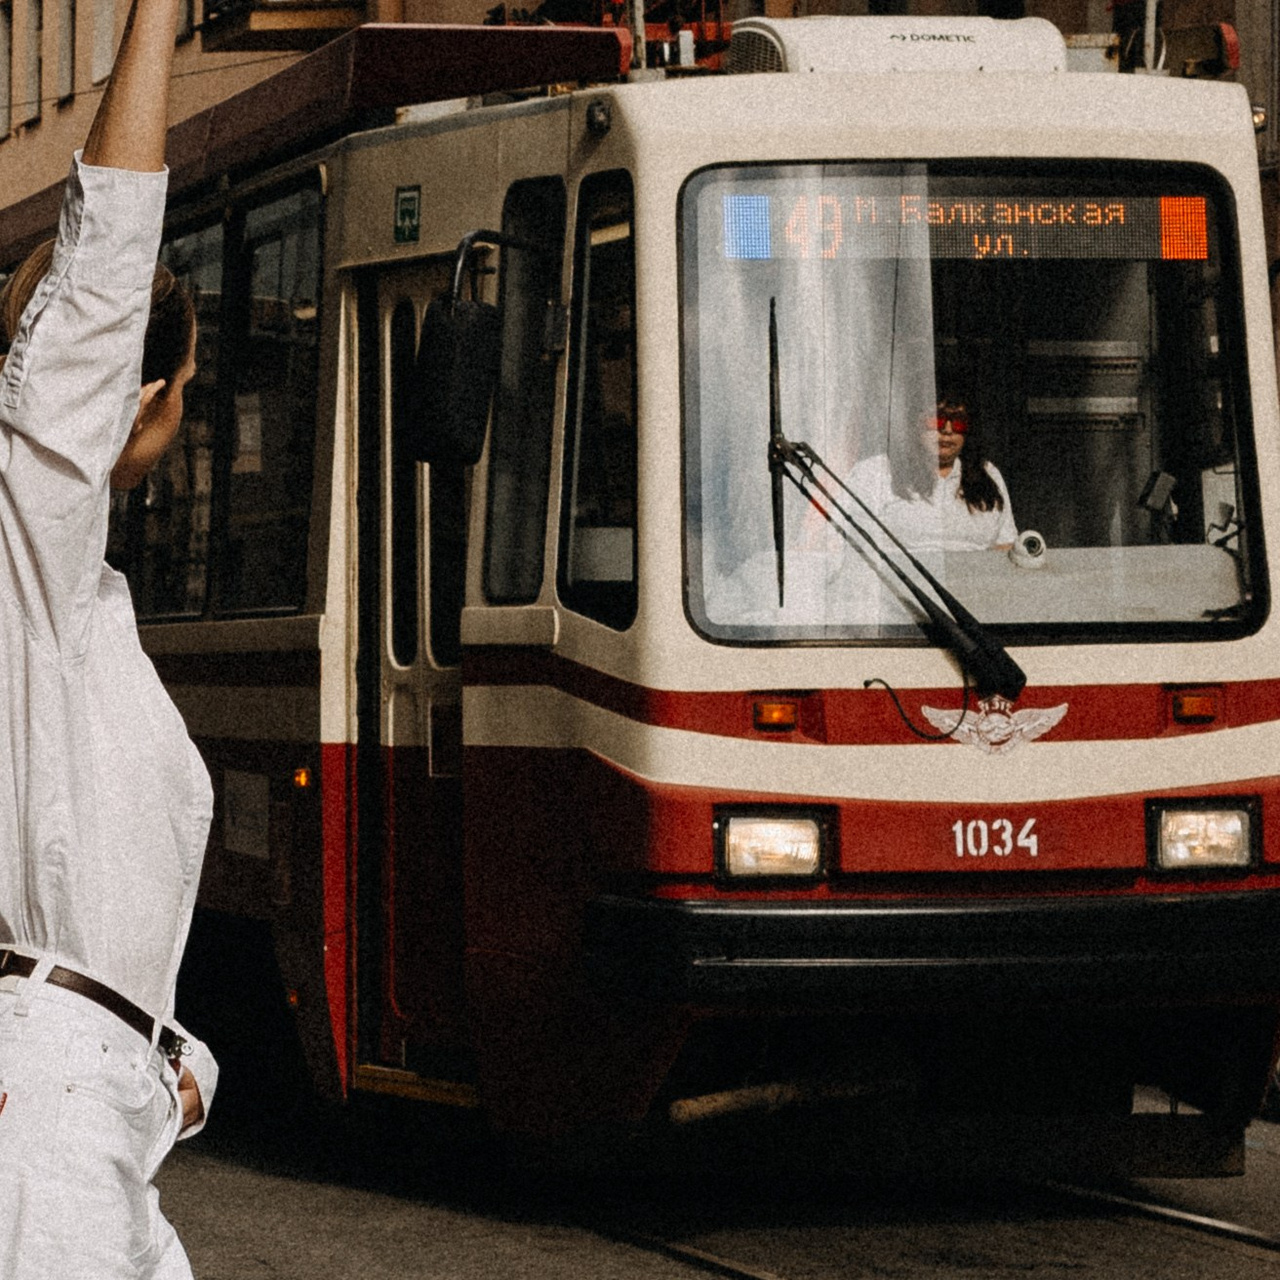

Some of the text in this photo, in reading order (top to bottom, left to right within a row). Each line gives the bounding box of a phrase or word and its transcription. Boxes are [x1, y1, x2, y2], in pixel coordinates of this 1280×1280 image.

[910, 33, 976, 43] DOMETIC
[900, 195, 1124, 224] Балканская
[952, 818, 1038, 857] 1034
